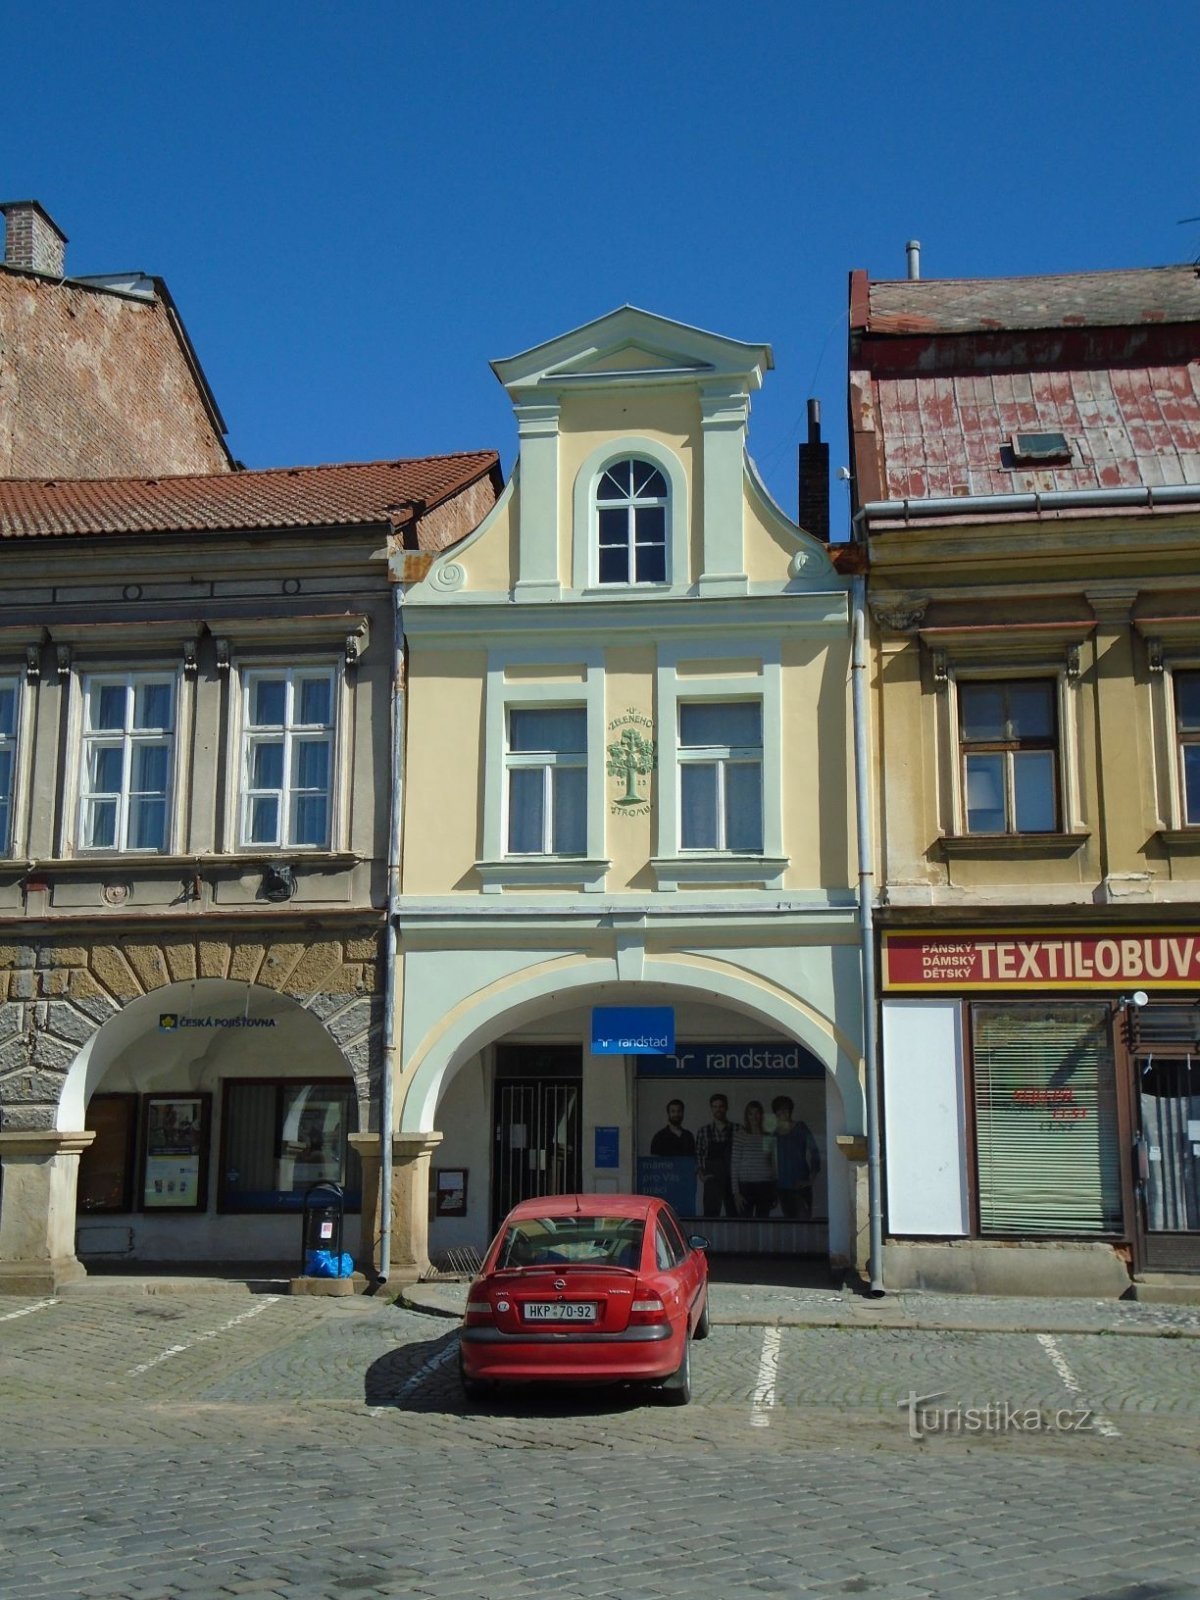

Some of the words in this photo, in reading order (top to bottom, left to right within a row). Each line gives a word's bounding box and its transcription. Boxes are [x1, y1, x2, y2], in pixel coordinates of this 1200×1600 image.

[921, 942, 973, 953] PÁNSKÝ
[922, 954, 977, 966] DÁMSKÝ
[923, 966, 972, 979] DĚTSKÝ
[180, 1016, 212, 1028] ČESKÁ
[618, 1035, 668, 1048] randstad
[706, 1048, 800, 1070] randstad
[529, 1306, 551, 1318] HKP
[560, 1305, 591, 1318] 70-92
